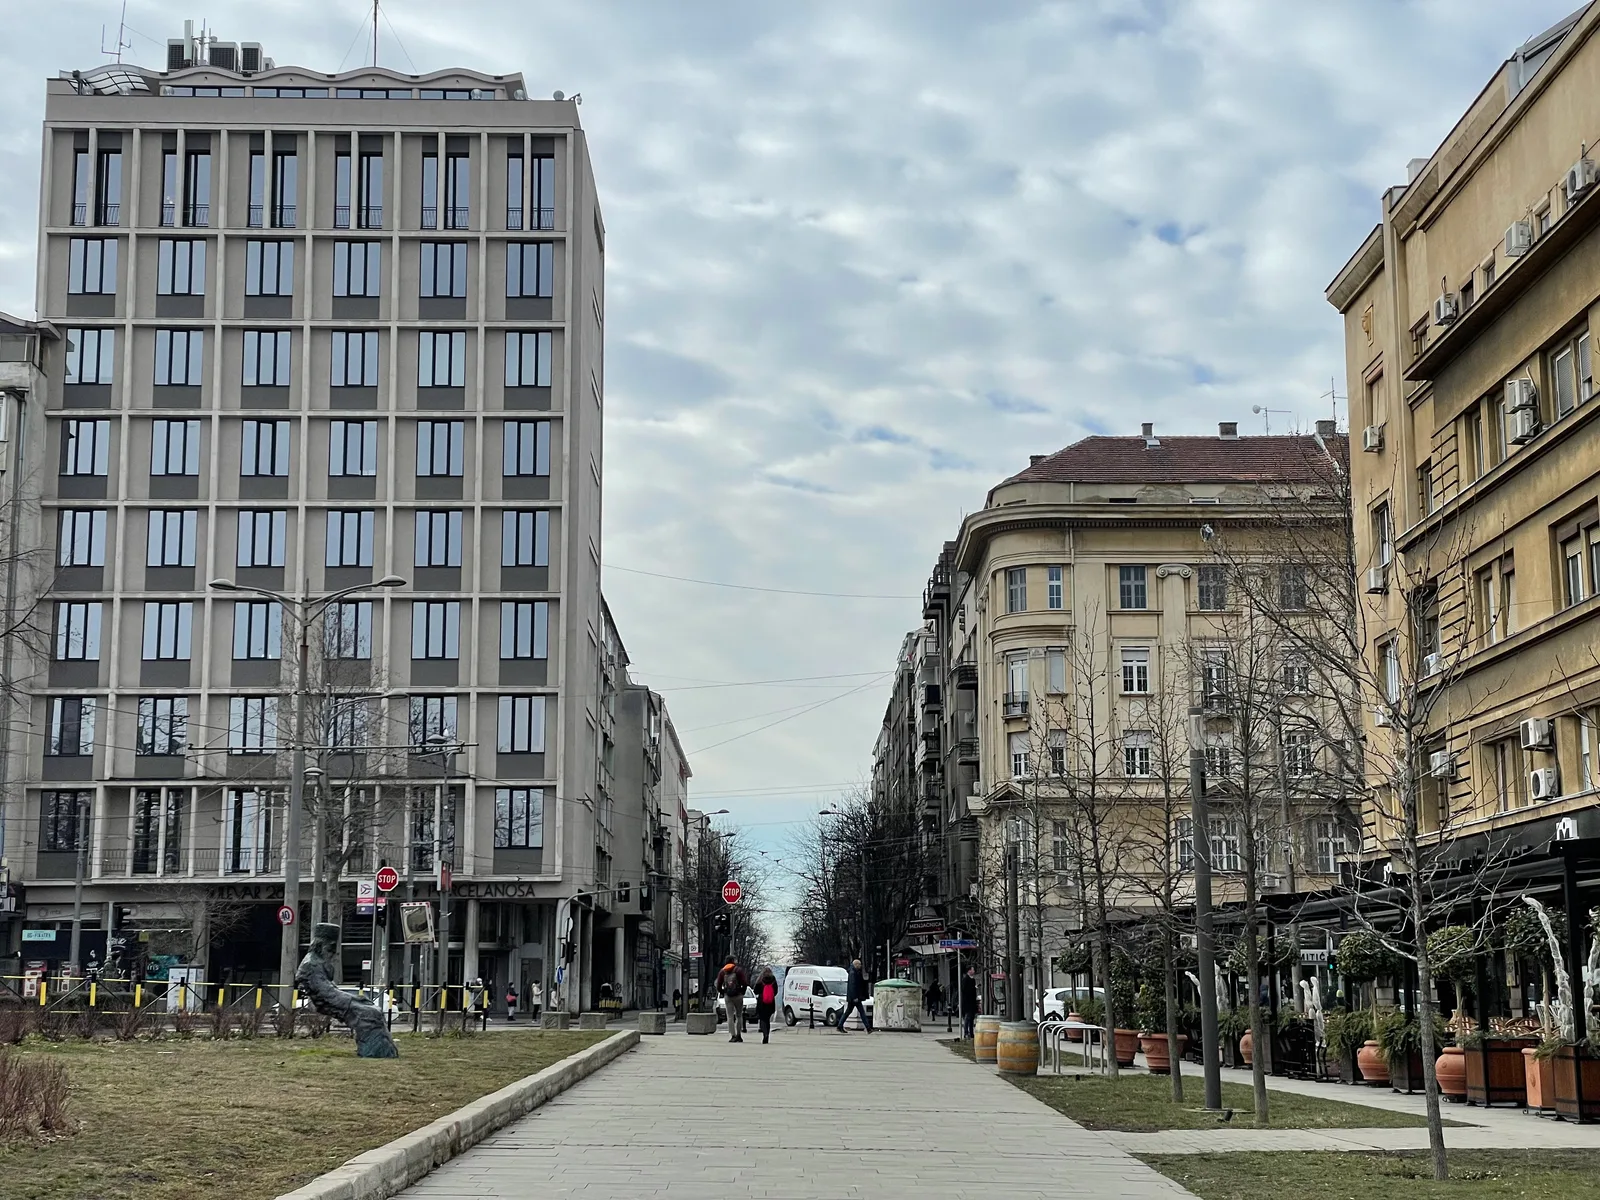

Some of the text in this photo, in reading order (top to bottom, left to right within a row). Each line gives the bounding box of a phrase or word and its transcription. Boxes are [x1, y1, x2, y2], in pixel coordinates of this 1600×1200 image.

[377, 874, 396, 884] STOP
[428, 883, 535, 898] PRCELANOSA
[724, 888, 740, 897] STOP
